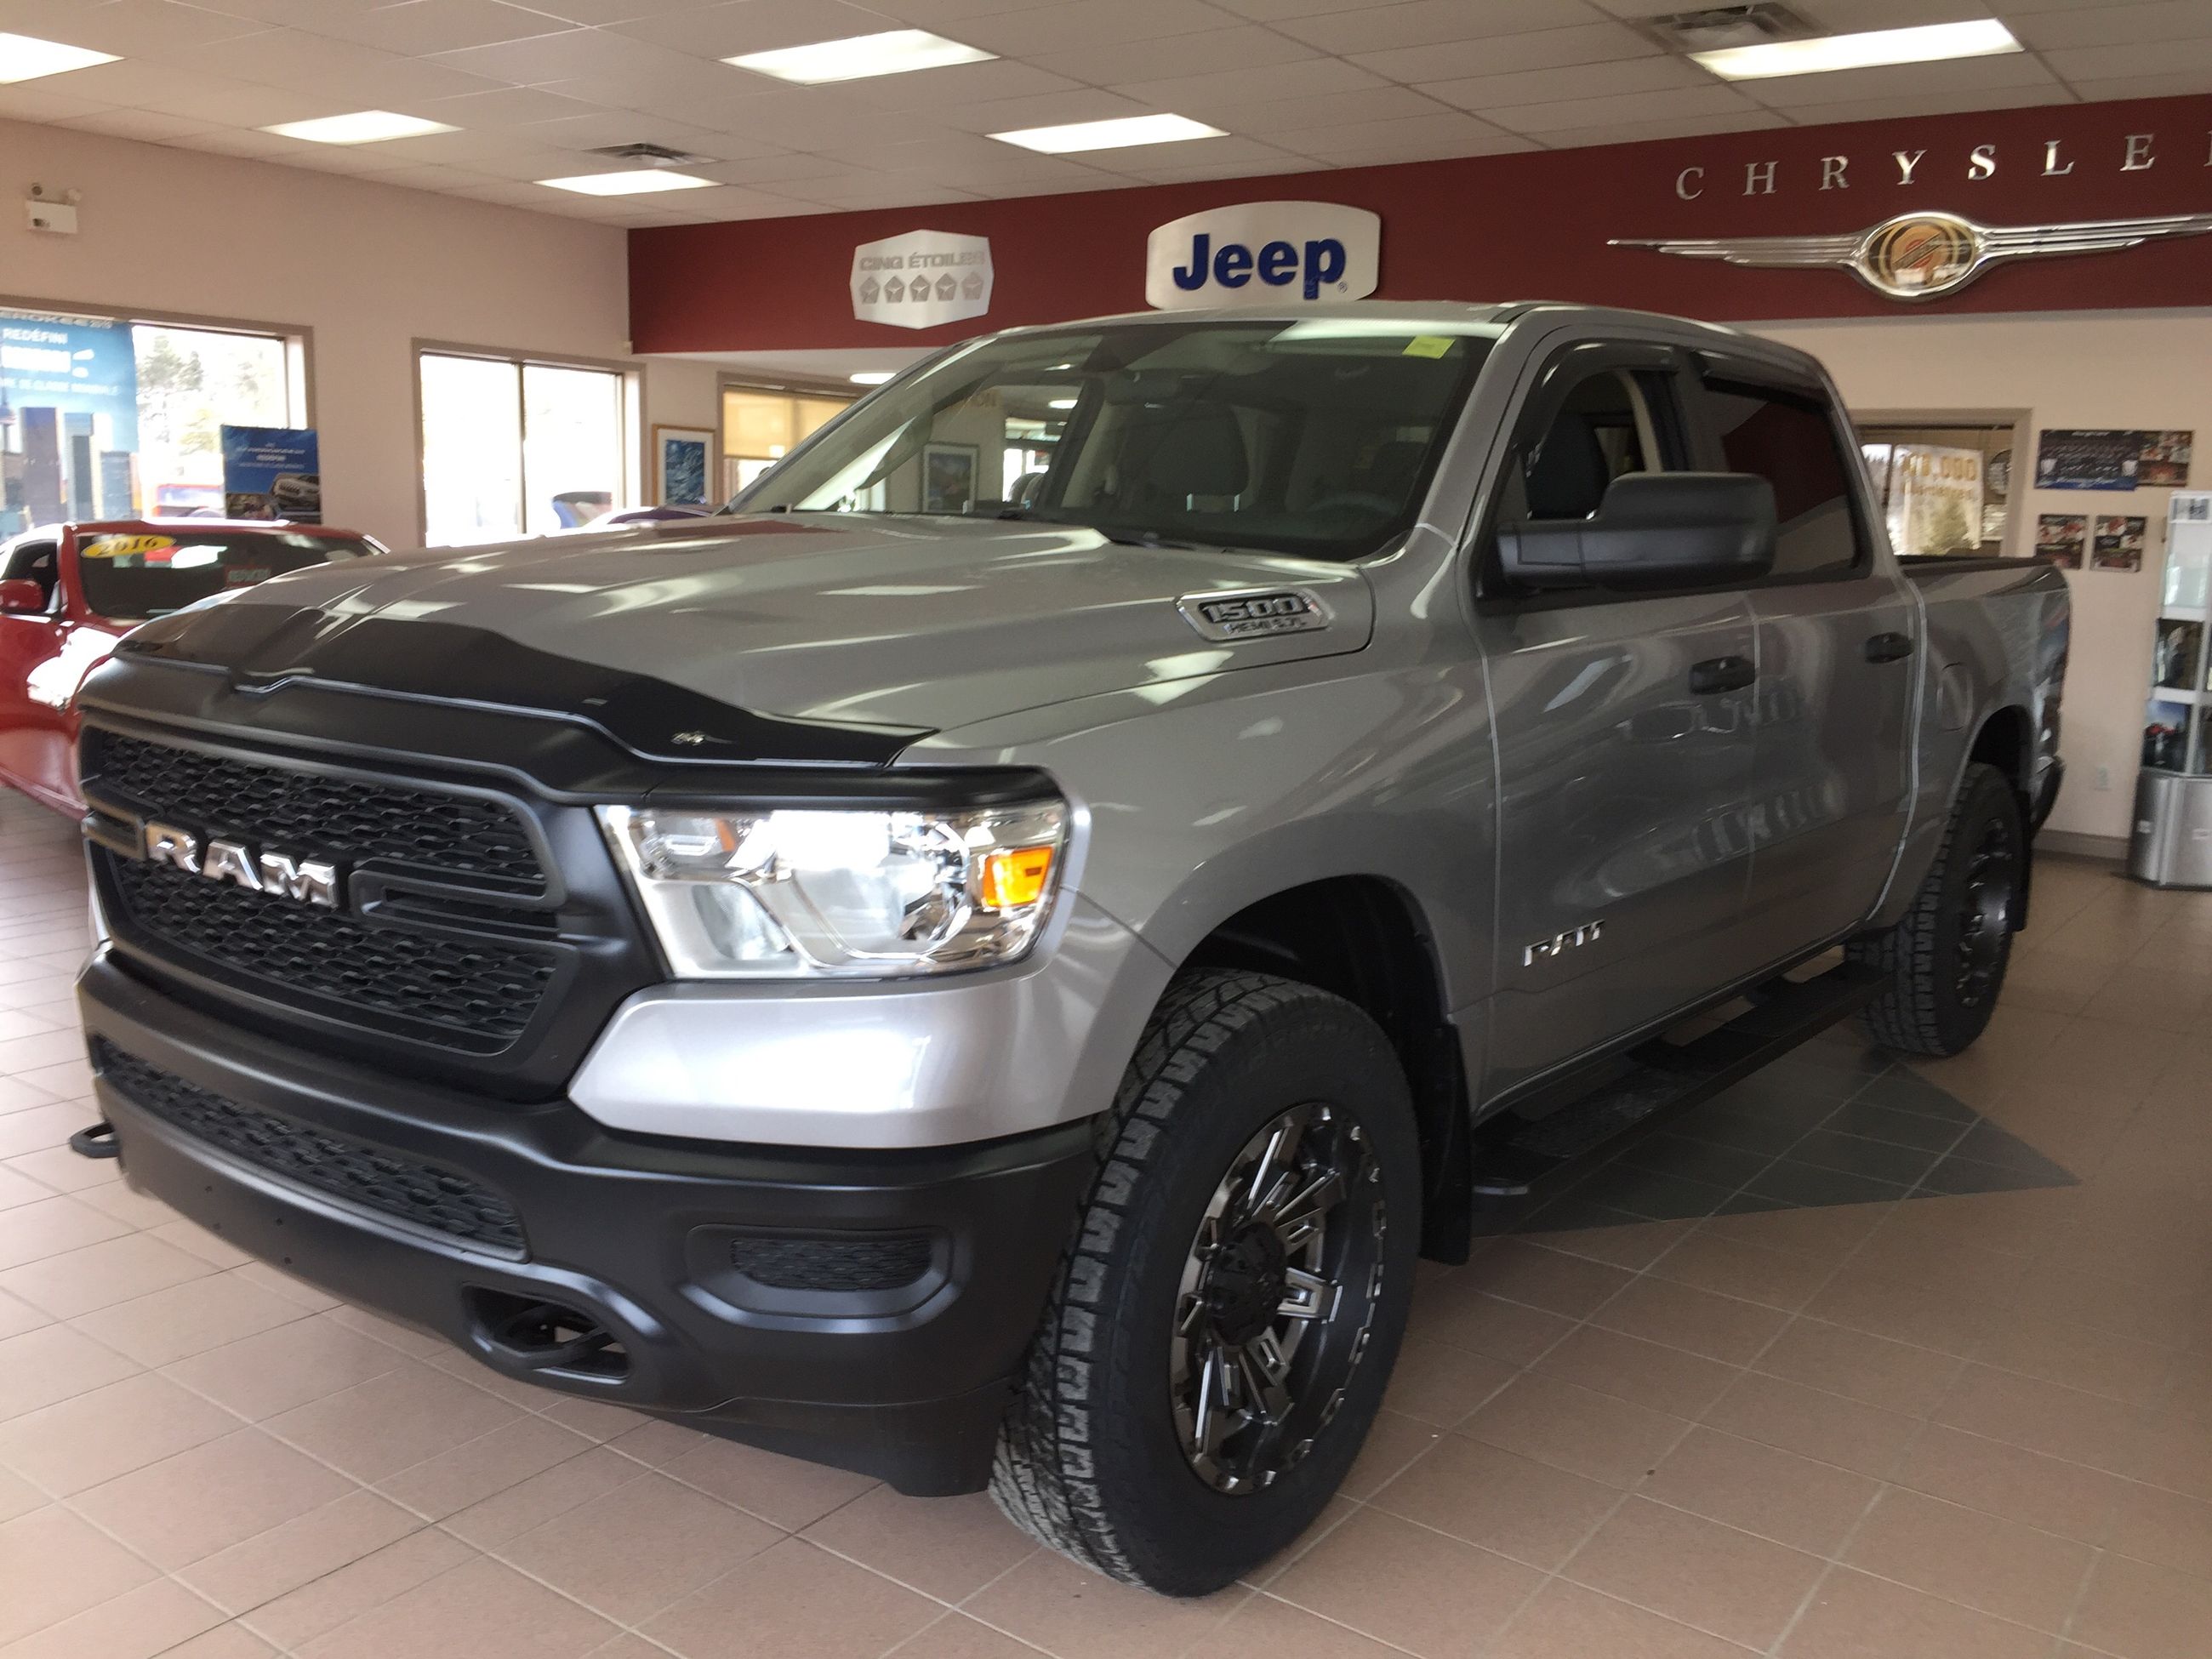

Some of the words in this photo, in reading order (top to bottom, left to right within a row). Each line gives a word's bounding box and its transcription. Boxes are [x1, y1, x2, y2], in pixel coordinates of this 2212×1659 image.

[1172, 233, 1346, 299] Jeep
[95, 538, 157, 557] 2016
[1200, 596, 1305, 623] 1500
[145, 821, 338, 909] RAM
